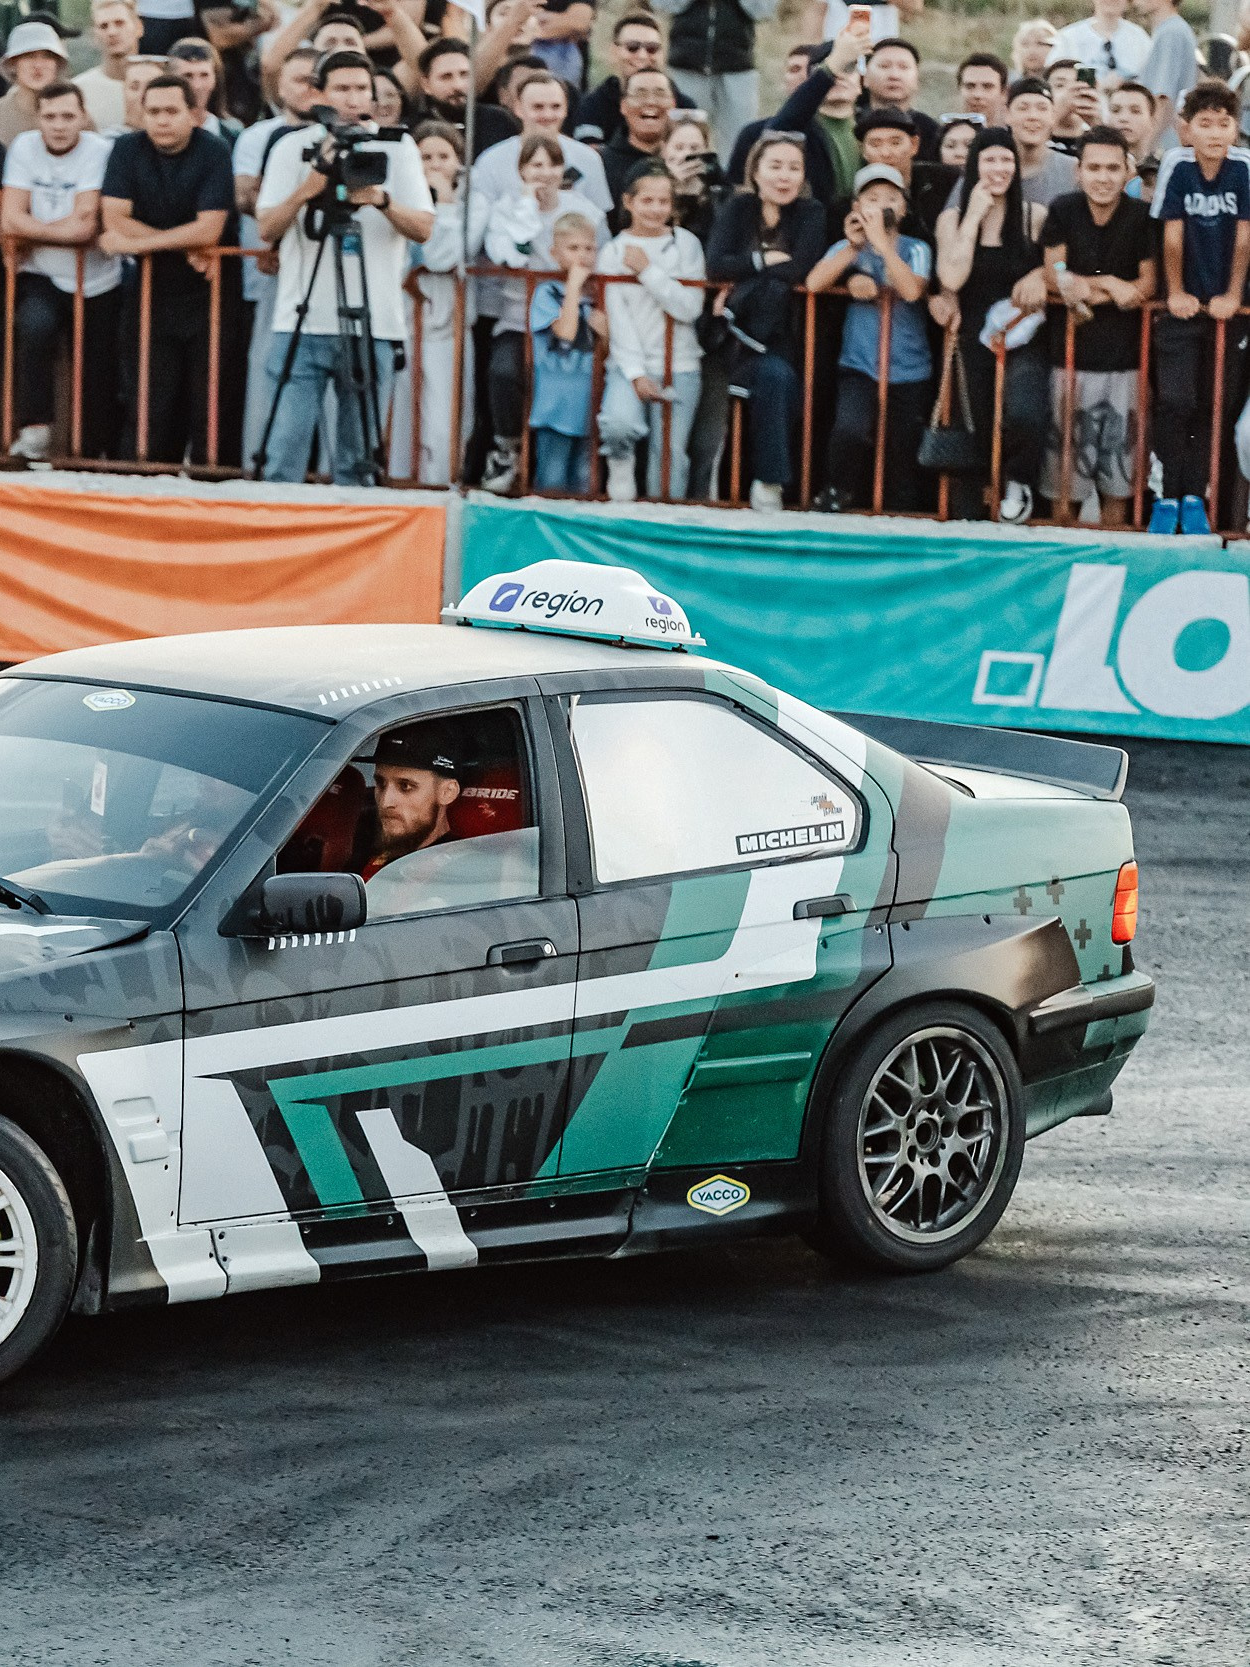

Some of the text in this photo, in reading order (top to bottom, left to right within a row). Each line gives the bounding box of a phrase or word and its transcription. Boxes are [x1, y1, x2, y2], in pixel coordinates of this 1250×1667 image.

[521, 587, 604, 619] region
[645, 615, 686, 634] region
[461, 787, 519, 800] BRIDE
[738, 822, 844, 854] MICHELIN
[698, 1189, 741, 1201] YACCO
